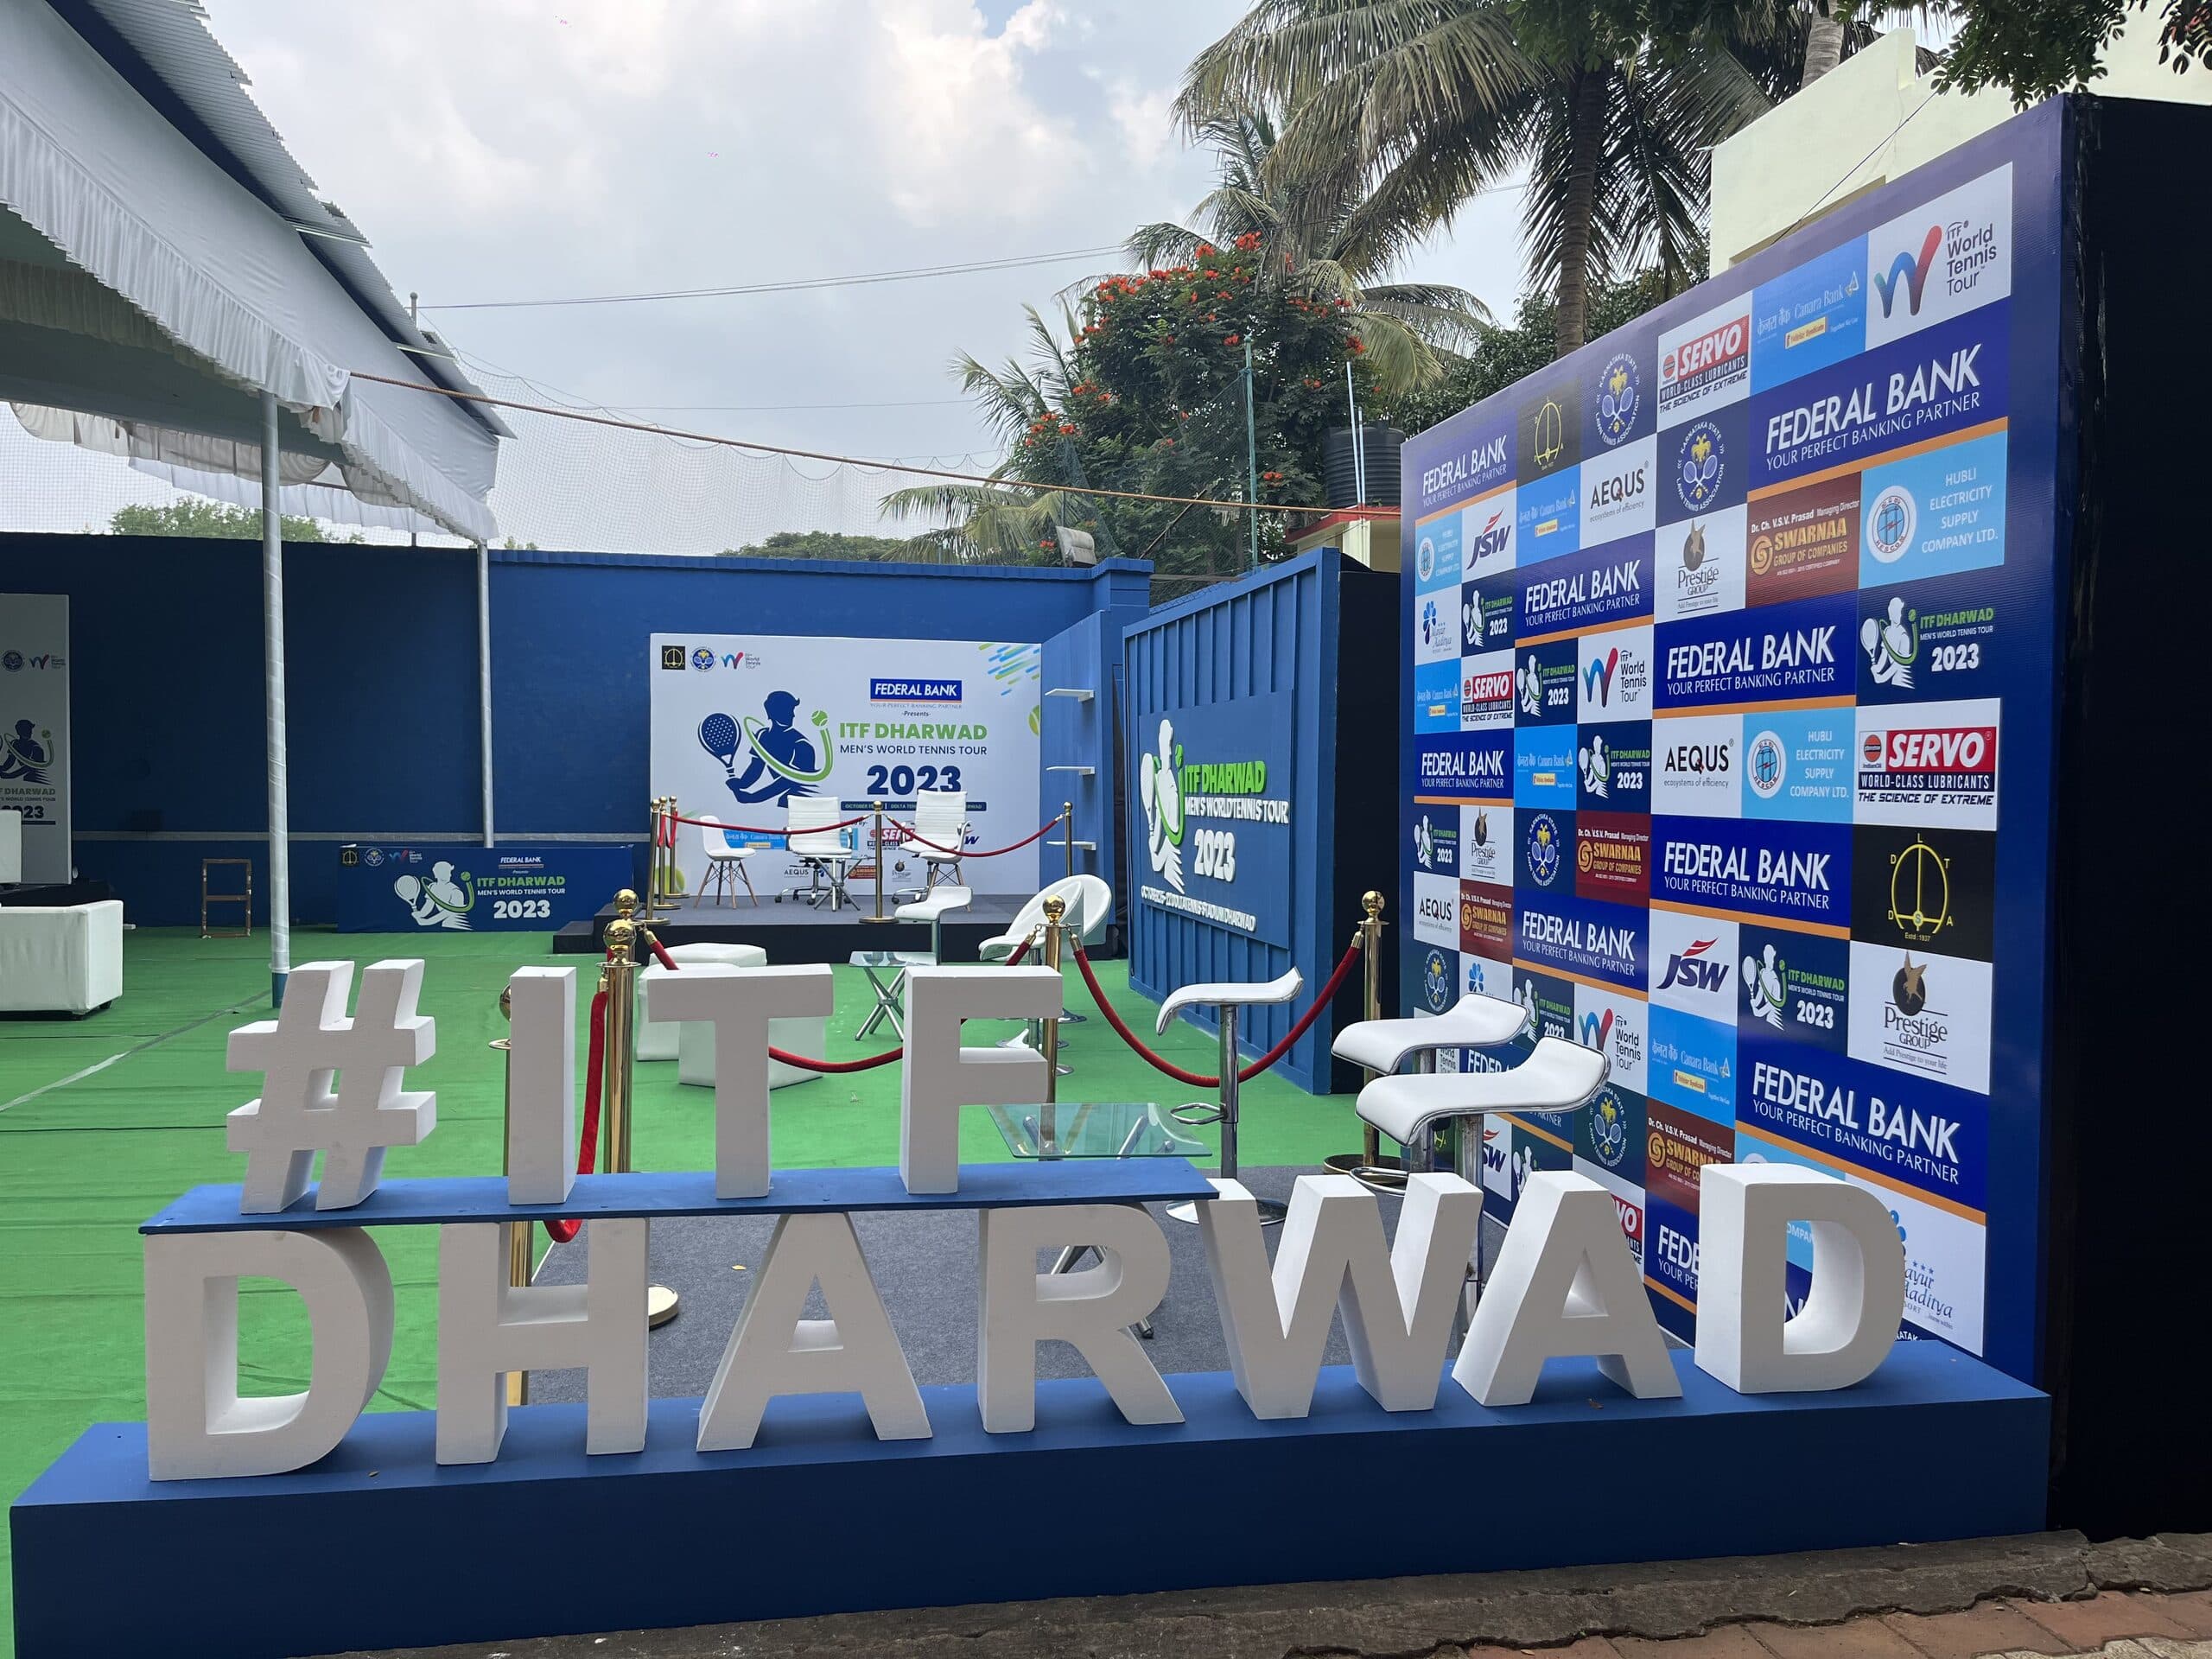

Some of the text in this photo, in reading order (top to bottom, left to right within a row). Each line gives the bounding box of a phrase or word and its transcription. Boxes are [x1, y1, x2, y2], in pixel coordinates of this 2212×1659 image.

[1948, 226, 1962, 239] ITF
[1948, 224, 1993, 258] World
[1947, 244, 1997, 277] Tennis
[1947, 270, 1980, 296] Tour
[1795, 285, 1844, 318] Canara Bank
[1680, 324, 1741, 376] SERVO
[1661, 356, 1745, 401] WORLD-CLASS LUBRICANTS
[1766, 343, 1981, 454] FEDERAL BANK
[1681, 422, 1721, 454] KARNATAKA STATE
[1766, 391, 1980, 471] YOUR PERFECT BANKING PARTNER
[1423, 435, 1507, 496] FEDERAL BANK
[1945, 467, 1977, 486] HUBLI
[1591, 468, 1644, 509] AEQUS
[1683, 499, 1699, 512] TENNIS
[1700, 464, 1724, 511] ASSOCIATION
[1929, 485, 1993, 511] ELECTRICITY
[1751, 499, 1860, 533] Dr. Ch. V.S.V. Prasad Managing Director
[1941, 510, 1978, 530] SUPPLY
[1466, 525, 1511, 569] JSW
[1774, 517, 1847, 551] SWARNAA
[1922, 528, 1998, 553] COMPANY LTD.
[1773, 541, 1848, 567] GROUP OF COMPANIES
[1525, 560, 1641, 613] FEDERAL BANK
[1677, 566, 1719, 589] Prestige
[1688, 584, 1708, 596] GROUP
[1489, 617, 1508, 636] 2023
[1920, 608, 1994, 629] ITF DHARWAD
[1937, 630, 1956, 639] WORLD
[1958, 627, 1977, 637] TENNIS
[1978, 626, 1993, 634] TOUR
[1667, 626, 1835, 679] FEDERAL BANK
[1931, 643, 1979, 671] 2023
[1620, 674, 1647, 689] Tennis
[1621, 661, 1645, 676] World
[874, 683, 957, 696] FEDERAL BANK
[1474, 675, 1509, 699] SERVO
[1548, 688, 1569, 706] 2023
[1620, 690, 1637, 702] Tour
[839, 722, 988, 741] ITF DHARWAD
[840, 745, 988, 755] MEN'S WORLD TENNIS TOUR
[1421, 750, 1504, 776] FEDERAL BANK
[1620, 749, 1650, 759] DHARWAD
[1664, 745, 1729, 774] AEQUS
[1889, 732, 1985, 768] SERVO
[868, 765, 962, 796] 2023
[1185, 760, 1266, 794] ITF DHARWAD
[1618, 772, 1643, 789] 2023
[1664, 778, 1728, 790] ecosystems of efficiency
[1861, 774, 1990, 789] WORLD-CLASS LUBRICANTS
[1206, 798, 1233, 818] WORLD
[1233, 798, 1262, 821] TENNIS
[1263, 800, 1289, 824] TOUR
[1859, 792, 1994, 805] THE SCIENCE OF EXTREME
[1194, 829, 1235, 882] 2023
[1471, 842, 1496, 861] Prestige
[1594, 842, 1641, 861] SWARNAA
[1664, 841, 1830, 891] FEDERAL BANK
[477, 876, 565, 887] ITF DHARWAD
[493, 899, 550, 918] 2023
[1419, 898, 1452, 921] AEQUS
[1472, 906, 1507, 925] SWARNAA
[1522, 911, 1635, 961] FEDERAL BANK
[1522, 939, 1635, 976] YOUR PERFECT BANKING PARTNER
[1656, 954, 1729, 993] JSW
[1789, 969, 1845, 991] ITF DHARWAD
[1796, 1000, 1834, 1029] 2023
[1885, 1007, 1948, 1043] Prestige
[1616, 1028, 1639, 1046] World
[1899, 1033, 1930, 1049] GROUP
[1616, 1041, 1641, 1060] Tennis
[1616, 1054, 1632, 1071] Tour
[1681, 1051, 1719, 1075] Canara Bank
[1884, 1046, 1895, 1056] Add
[1896, 1050, 1916, 1062] Prestige
[1938, 1060, 1948, 1069] life
[1752, 1062, 1960, 1163] FEDERAL BANK
[1753, 1099, 1959, 1185] YOUR PERFECT BANKING PARTNER
[1904, 1268, 1934, 1288] ayur
[1904, 1281, 1953, 1319] aditya
[142, 1163, 1904, 1483] DHARWAD
